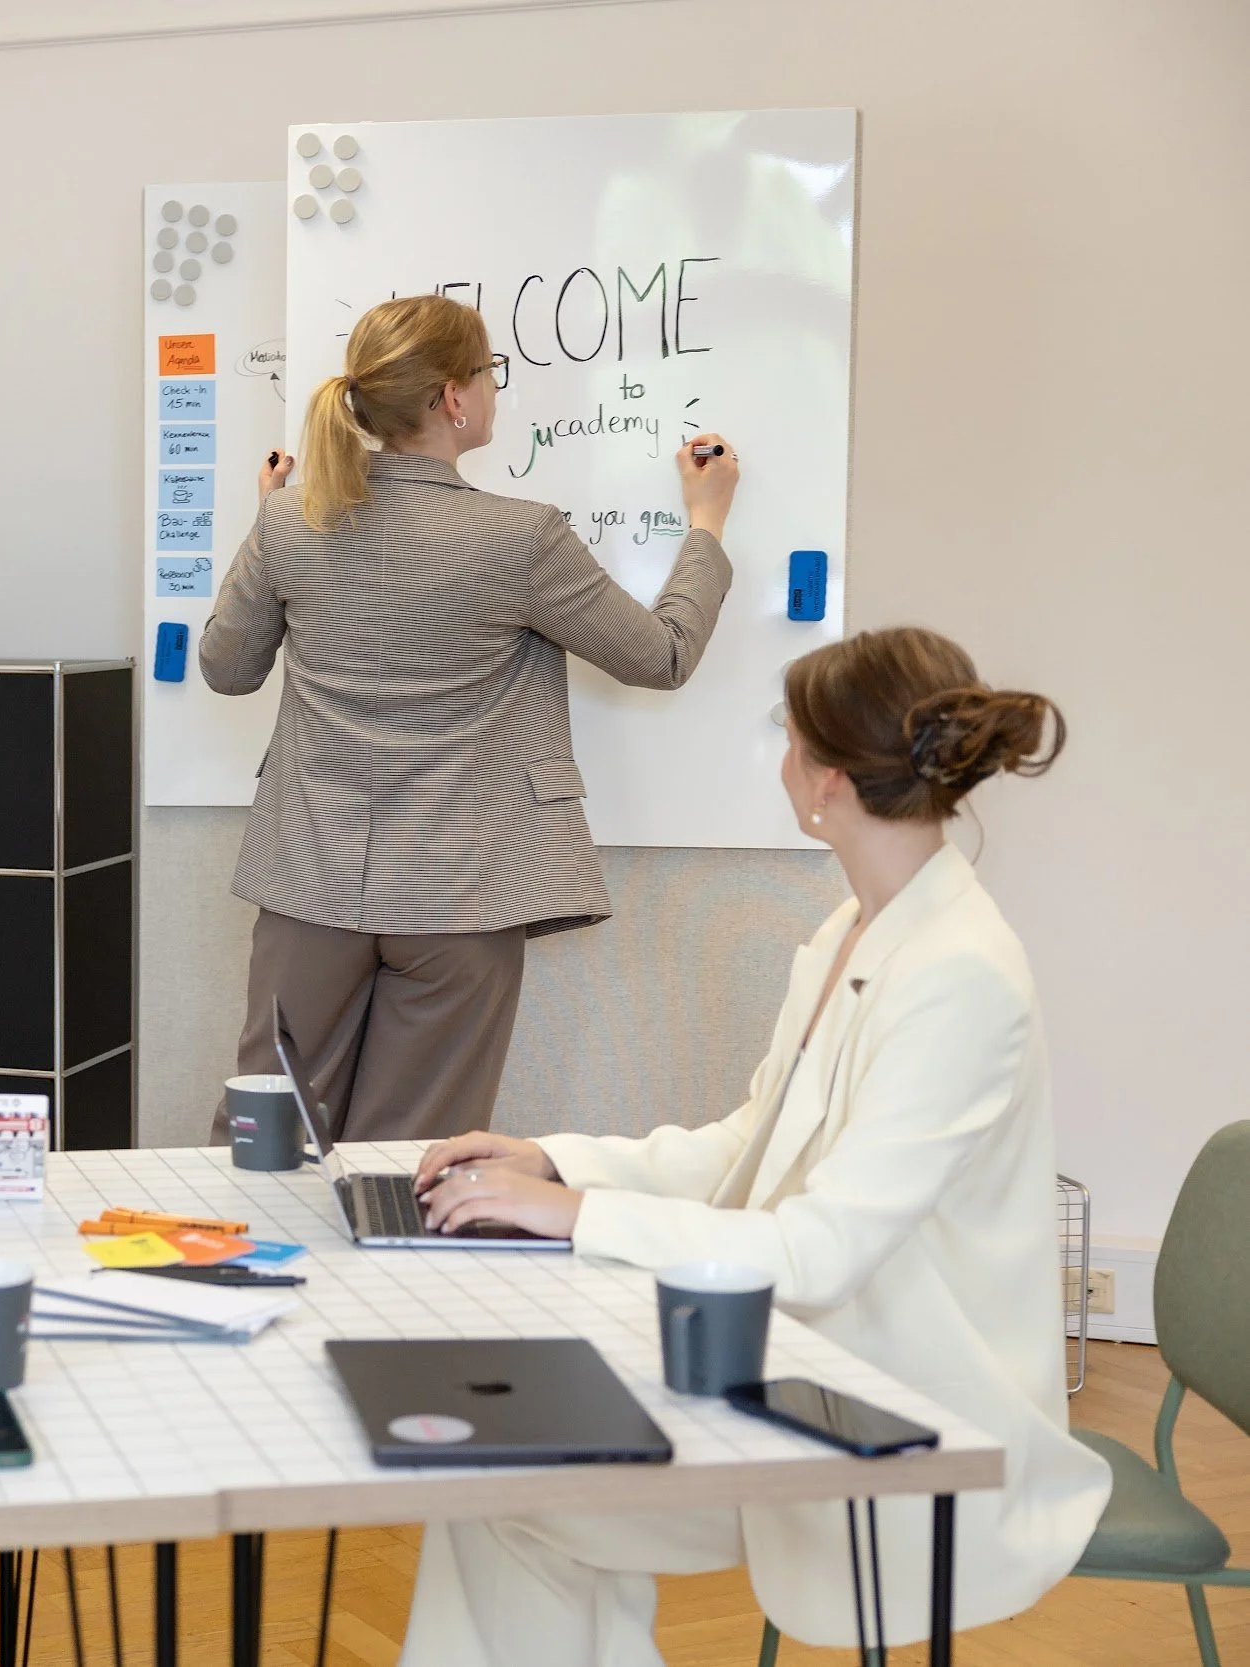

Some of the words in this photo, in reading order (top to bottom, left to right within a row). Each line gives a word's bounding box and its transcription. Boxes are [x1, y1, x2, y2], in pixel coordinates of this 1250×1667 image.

[391, 256, 721, 367] COME
[164, 340, 196, 350] Unsere
[166, 355, 200, 369] Agenda
[619, 373, 646, 400] to
[166, 398, 185, 410] 15
[508, 403, 660, 479] jucademy
[168, 443, 181, 455] 60
[590, 510, 626, 545] you
[159, 530, 201, 540] Challenge
[168, 582, 180, 592] 30
